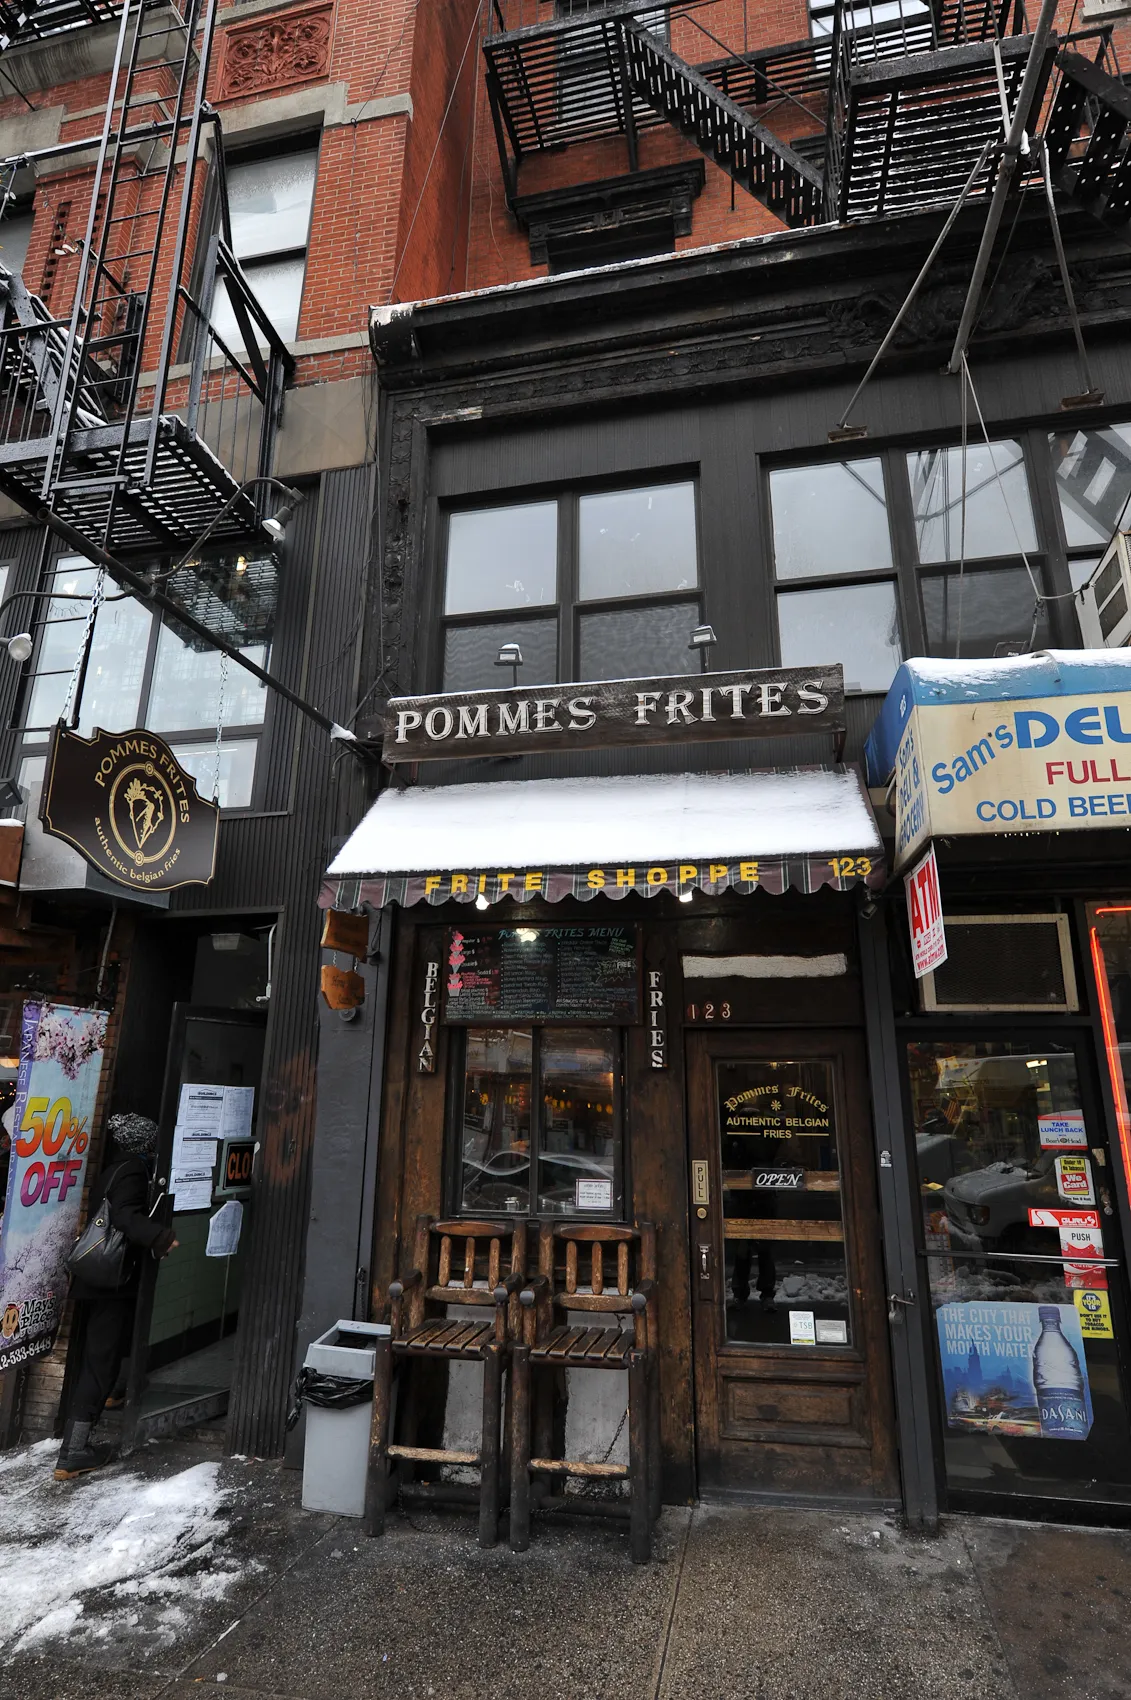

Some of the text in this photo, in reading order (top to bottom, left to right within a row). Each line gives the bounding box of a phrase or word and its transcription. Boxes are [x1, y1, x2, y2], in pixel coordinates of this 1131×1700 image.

[394, 680, 830, 744] POMMES FRITES
[931, 724, 1014, 794] Sam's
[1045, 759, 1131, 785] FULL
[95, 739, 190, 823] POMMES FRITES
[976, 793, 1131, 822] COLD BEE
[95, 817, 181, 883] authentic belgian fries
[425, 856, 872, 895] FRITE SHOPPE 123
[910, 854, 940, 939] ATM
[588, 927, 624, 937] MENU
[419, 962, 439, 1071] BELGIAN
[648, 971, 665, 1068] FRIES
[18, 1019, 38, 1086] JAPANESE
[724, 1084, 829, 1113] Pommes Frites
[15, 1096, 89, 1158] 50%
[726, 1117, 829, 1127] AUTHENTIC BELGIAN
[763, 1129, 792, 1138] FRIES
[227, 1152, 253, 1181] CLO
[756, 1173, 802, 1186] OPEN
[1065, 1174, 1082, 1182] We
[20, 1159, 83, 1208] OFF
[1063, 1181, 1087, 1189] Card
[1071, 1232, 1091, 1241] PUSH
[20, 1310, 53, 1330] Place
[942, 1307, 1032, 1325] THE CITY THAT
[945, 1324, 1033, 1342] MAKES YOUR
[946, 1340, 990, 1356] MOUTH
[1042, 1404, 1086, 1423] DASANI
